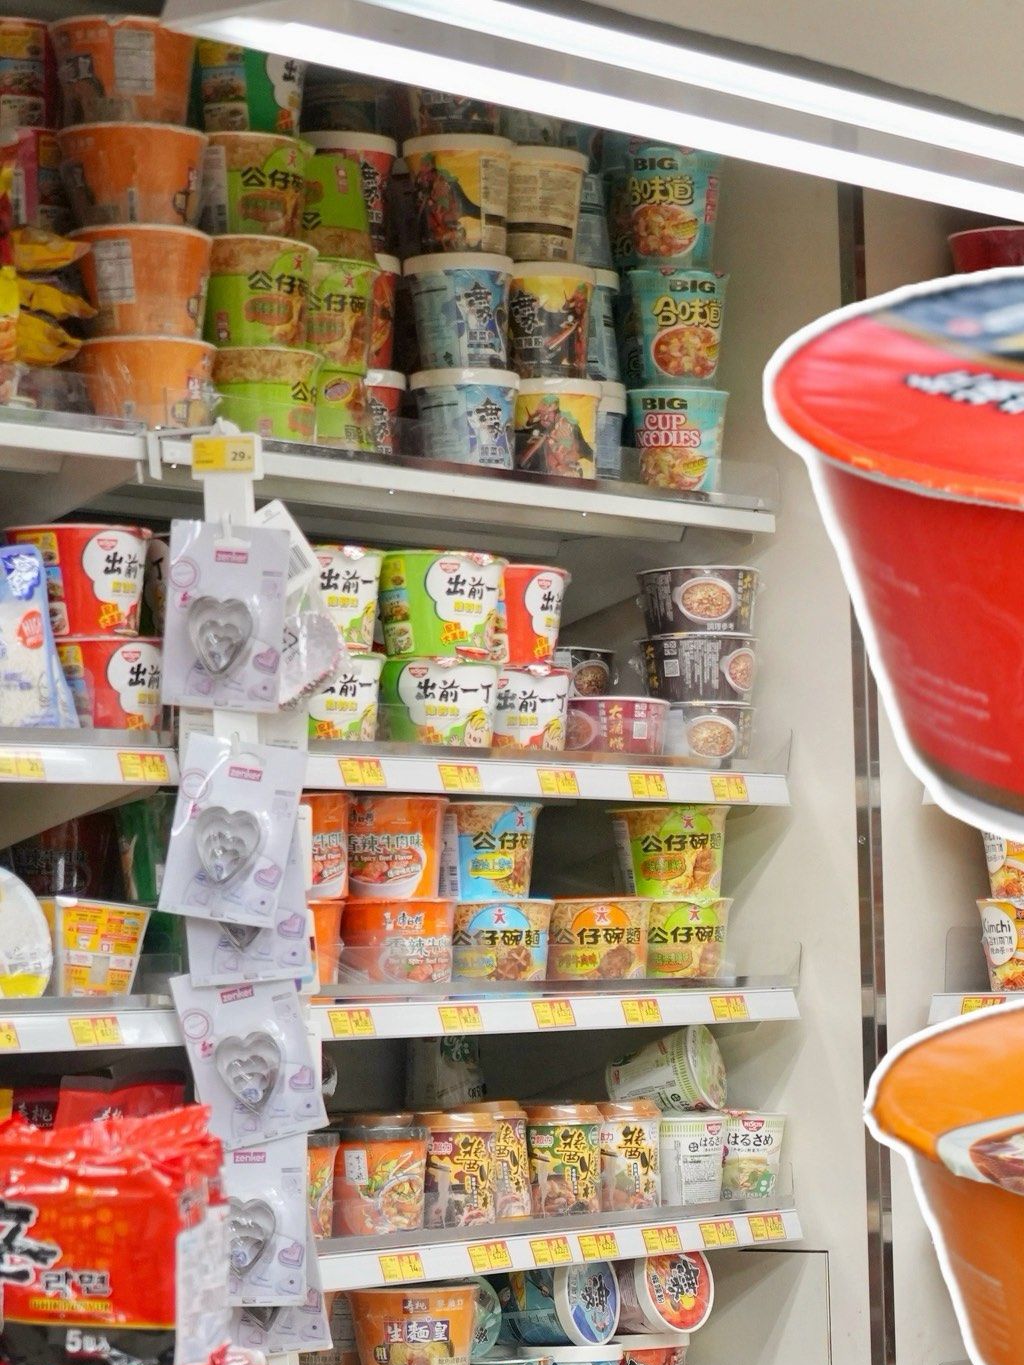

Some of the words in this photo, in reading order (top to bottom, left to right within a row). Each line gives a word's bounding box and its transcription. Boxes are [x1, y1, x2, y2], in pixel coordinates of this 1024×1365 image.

[633, 156, 678, 172] BIG
[668, 279, 716, 294] BIG
[653, 295, 722, 328] 合味道
[641, 397, 688, 411] BIG
[644, 412, 687, 432] CUP
[634, 430, 702, 449] NOODLES
[221, 987, 254, 1002] zenker
[727, 1131, 774, 1148] はるさめ
[235, 1153, 266, 1163] zenker
